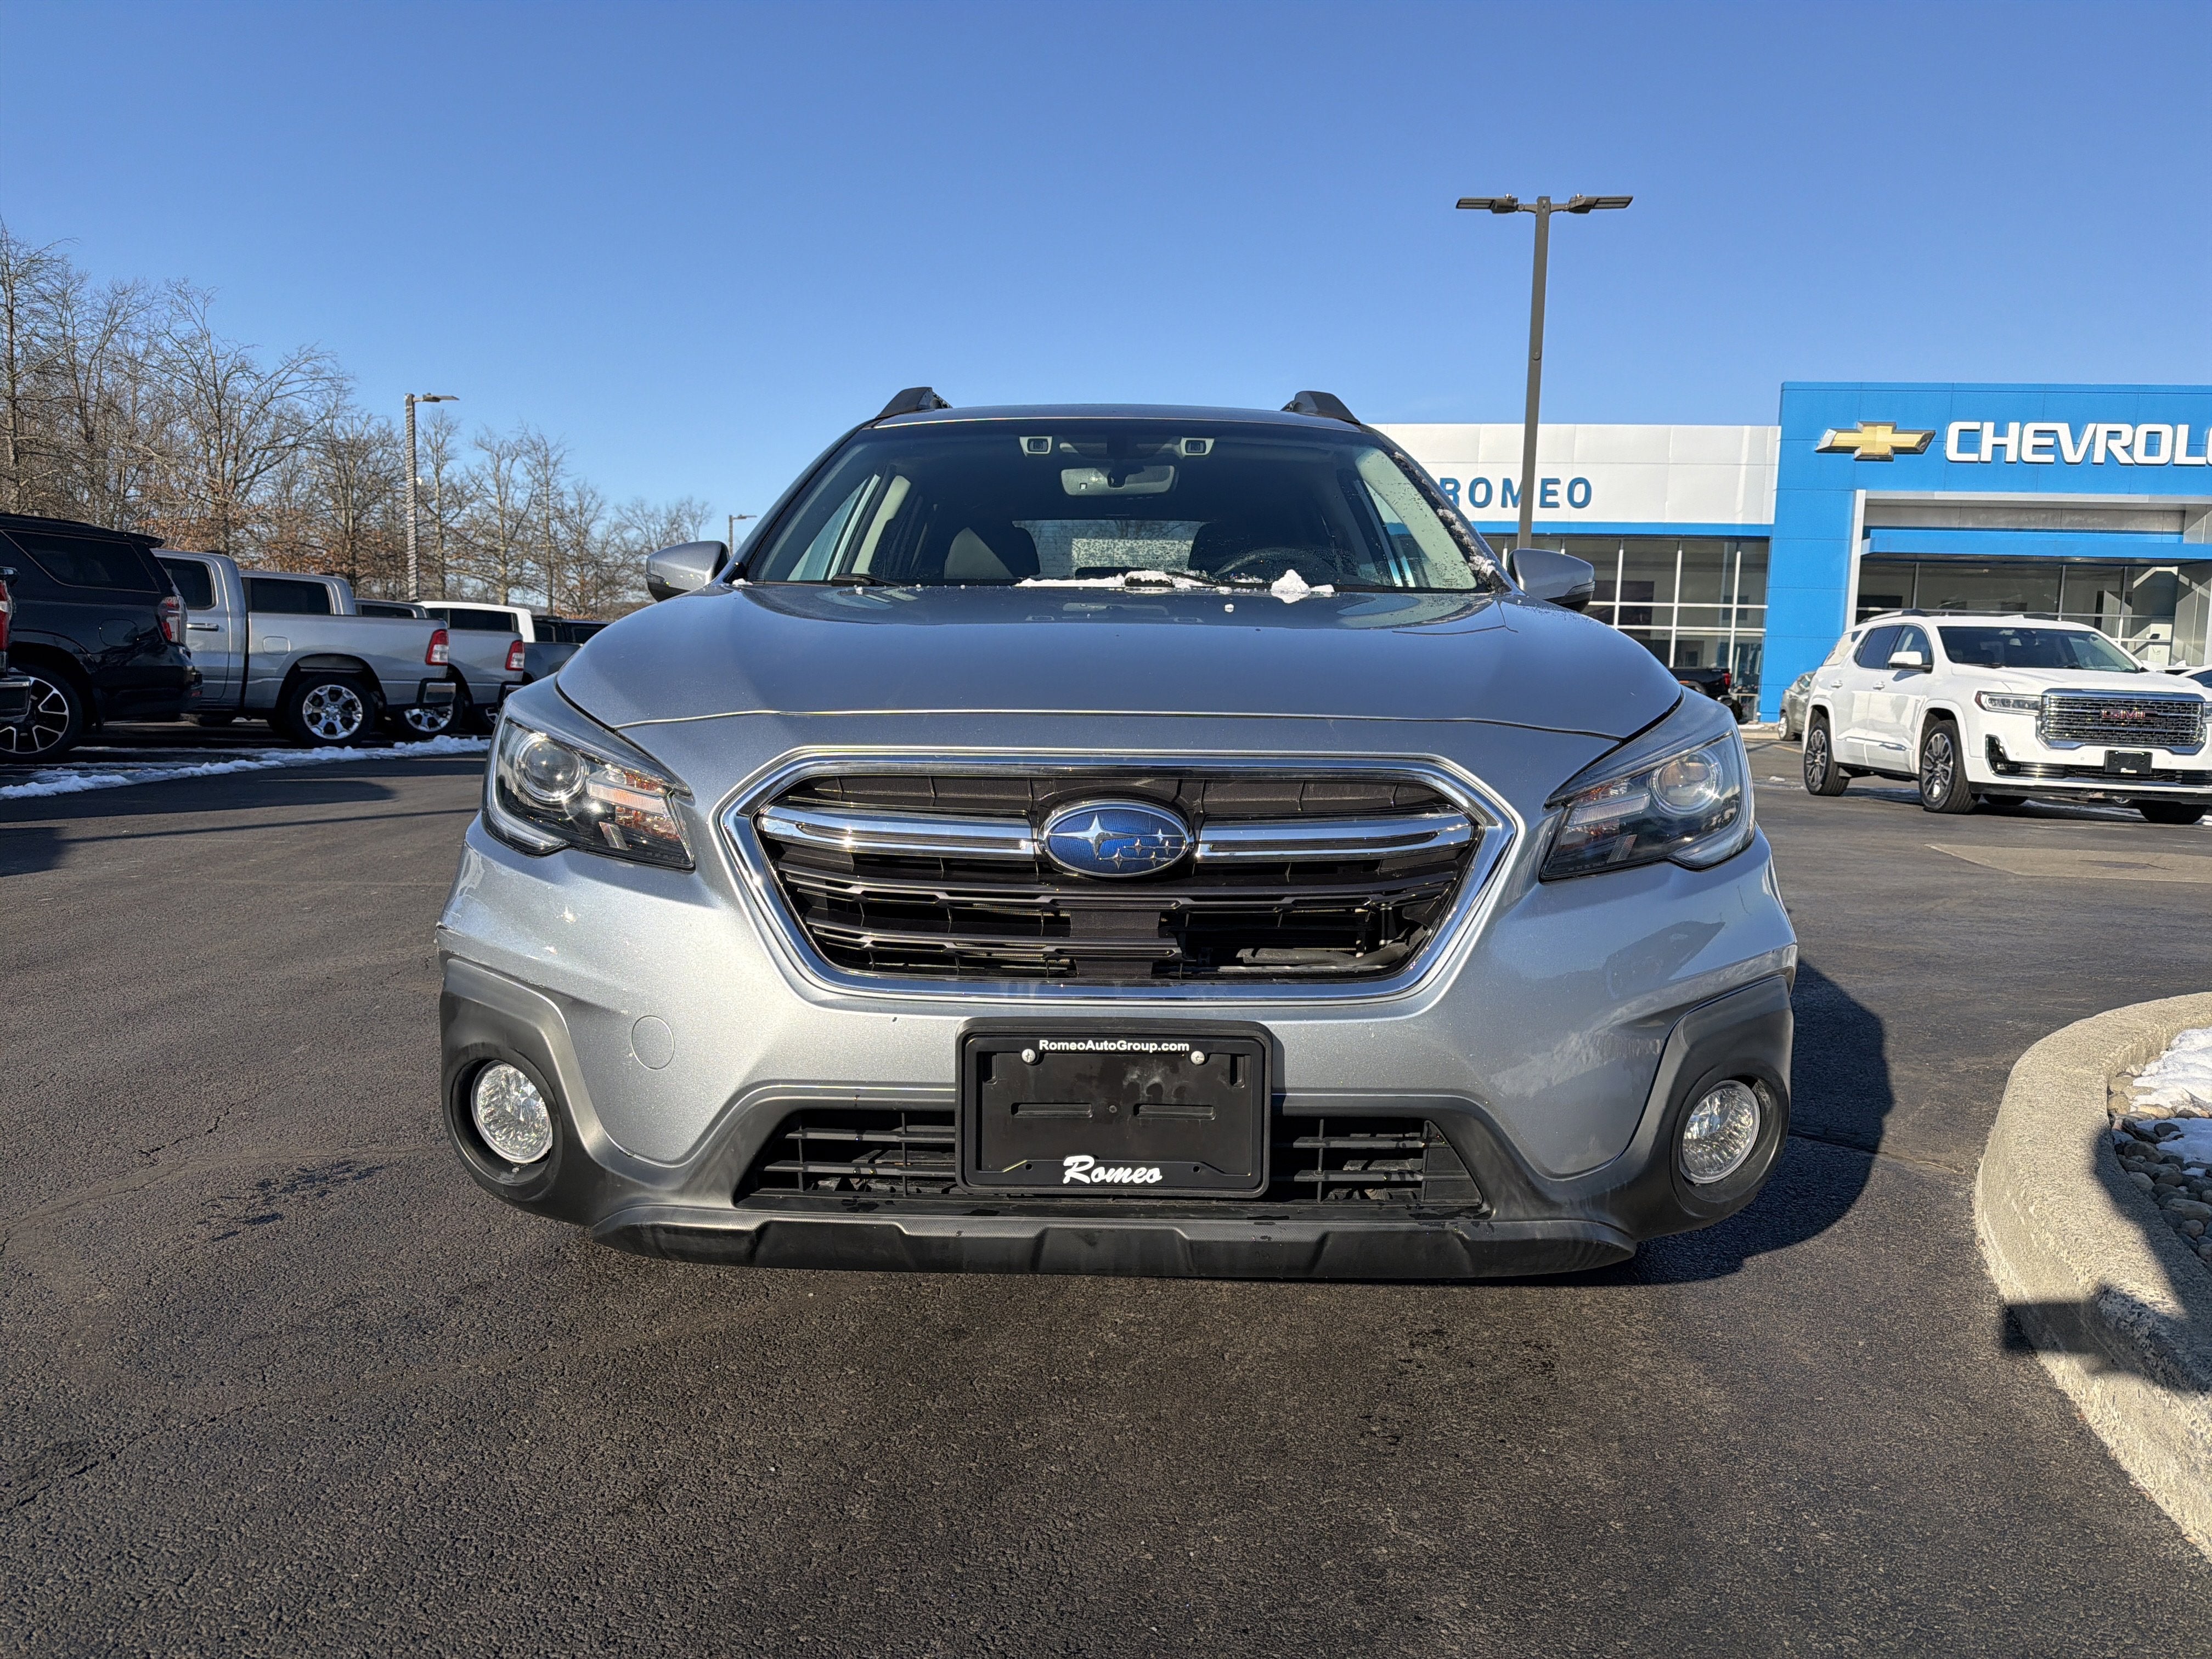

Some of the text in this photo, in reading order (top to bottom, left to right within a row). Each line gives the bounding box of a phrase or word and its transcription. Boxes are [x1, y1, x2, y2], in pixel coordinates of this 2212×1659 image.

[1946, 421, 2212, 465] CHEVROL
[1439, 477, 1592, 509] ROMEO
[2101, 709, 2158, 720] GMC
[1039, 1039, 1190, 1053] RomeoAutoGroup.com
[1063, 1155, 1163, 1184] Romeo
